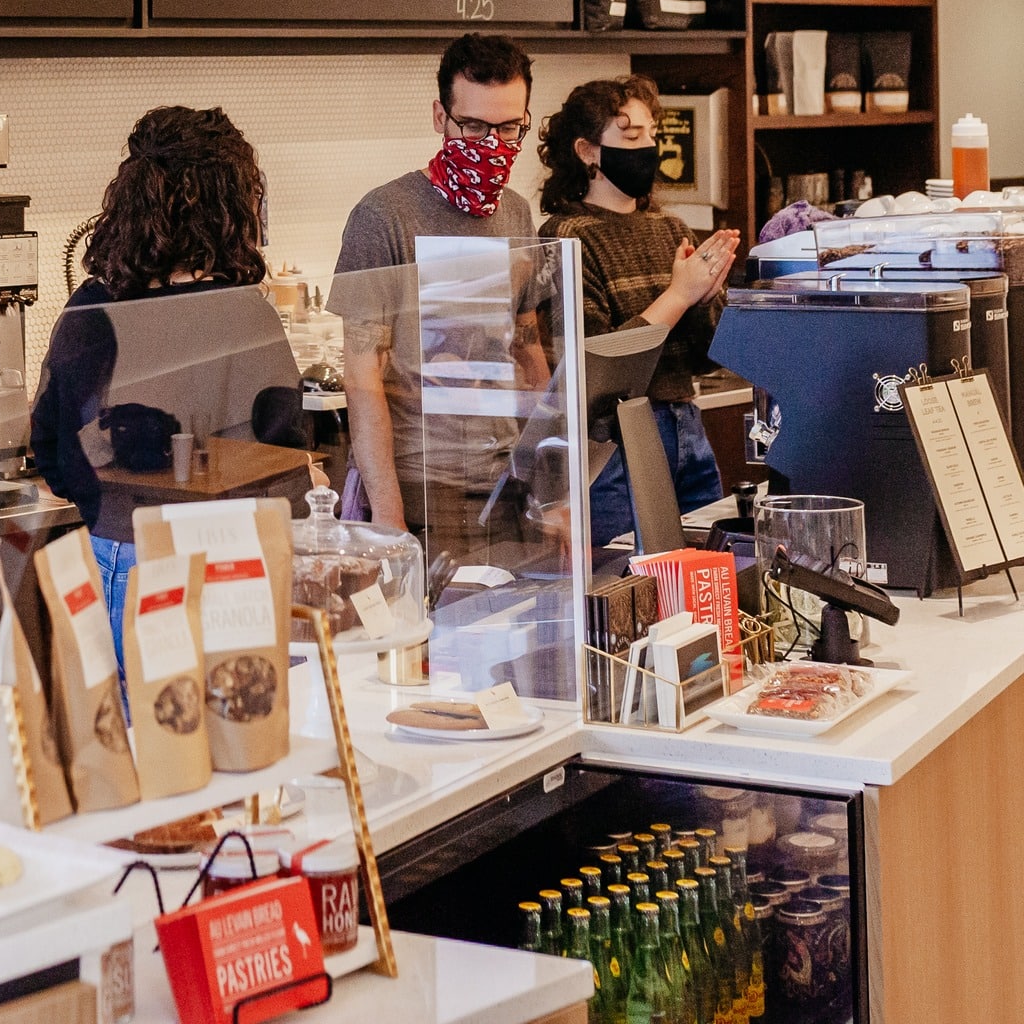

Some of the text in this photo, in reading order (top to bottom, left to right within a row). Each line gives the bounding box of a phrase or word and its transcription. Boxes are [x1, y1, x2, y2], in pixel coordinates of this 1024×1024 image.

[697, 568, 713, 624] PASTR
[722, 582, 732, 617] LEVAIN
[723, 619, 734, 649] BREA
[216, 943, 293, 997] PASTRIES
